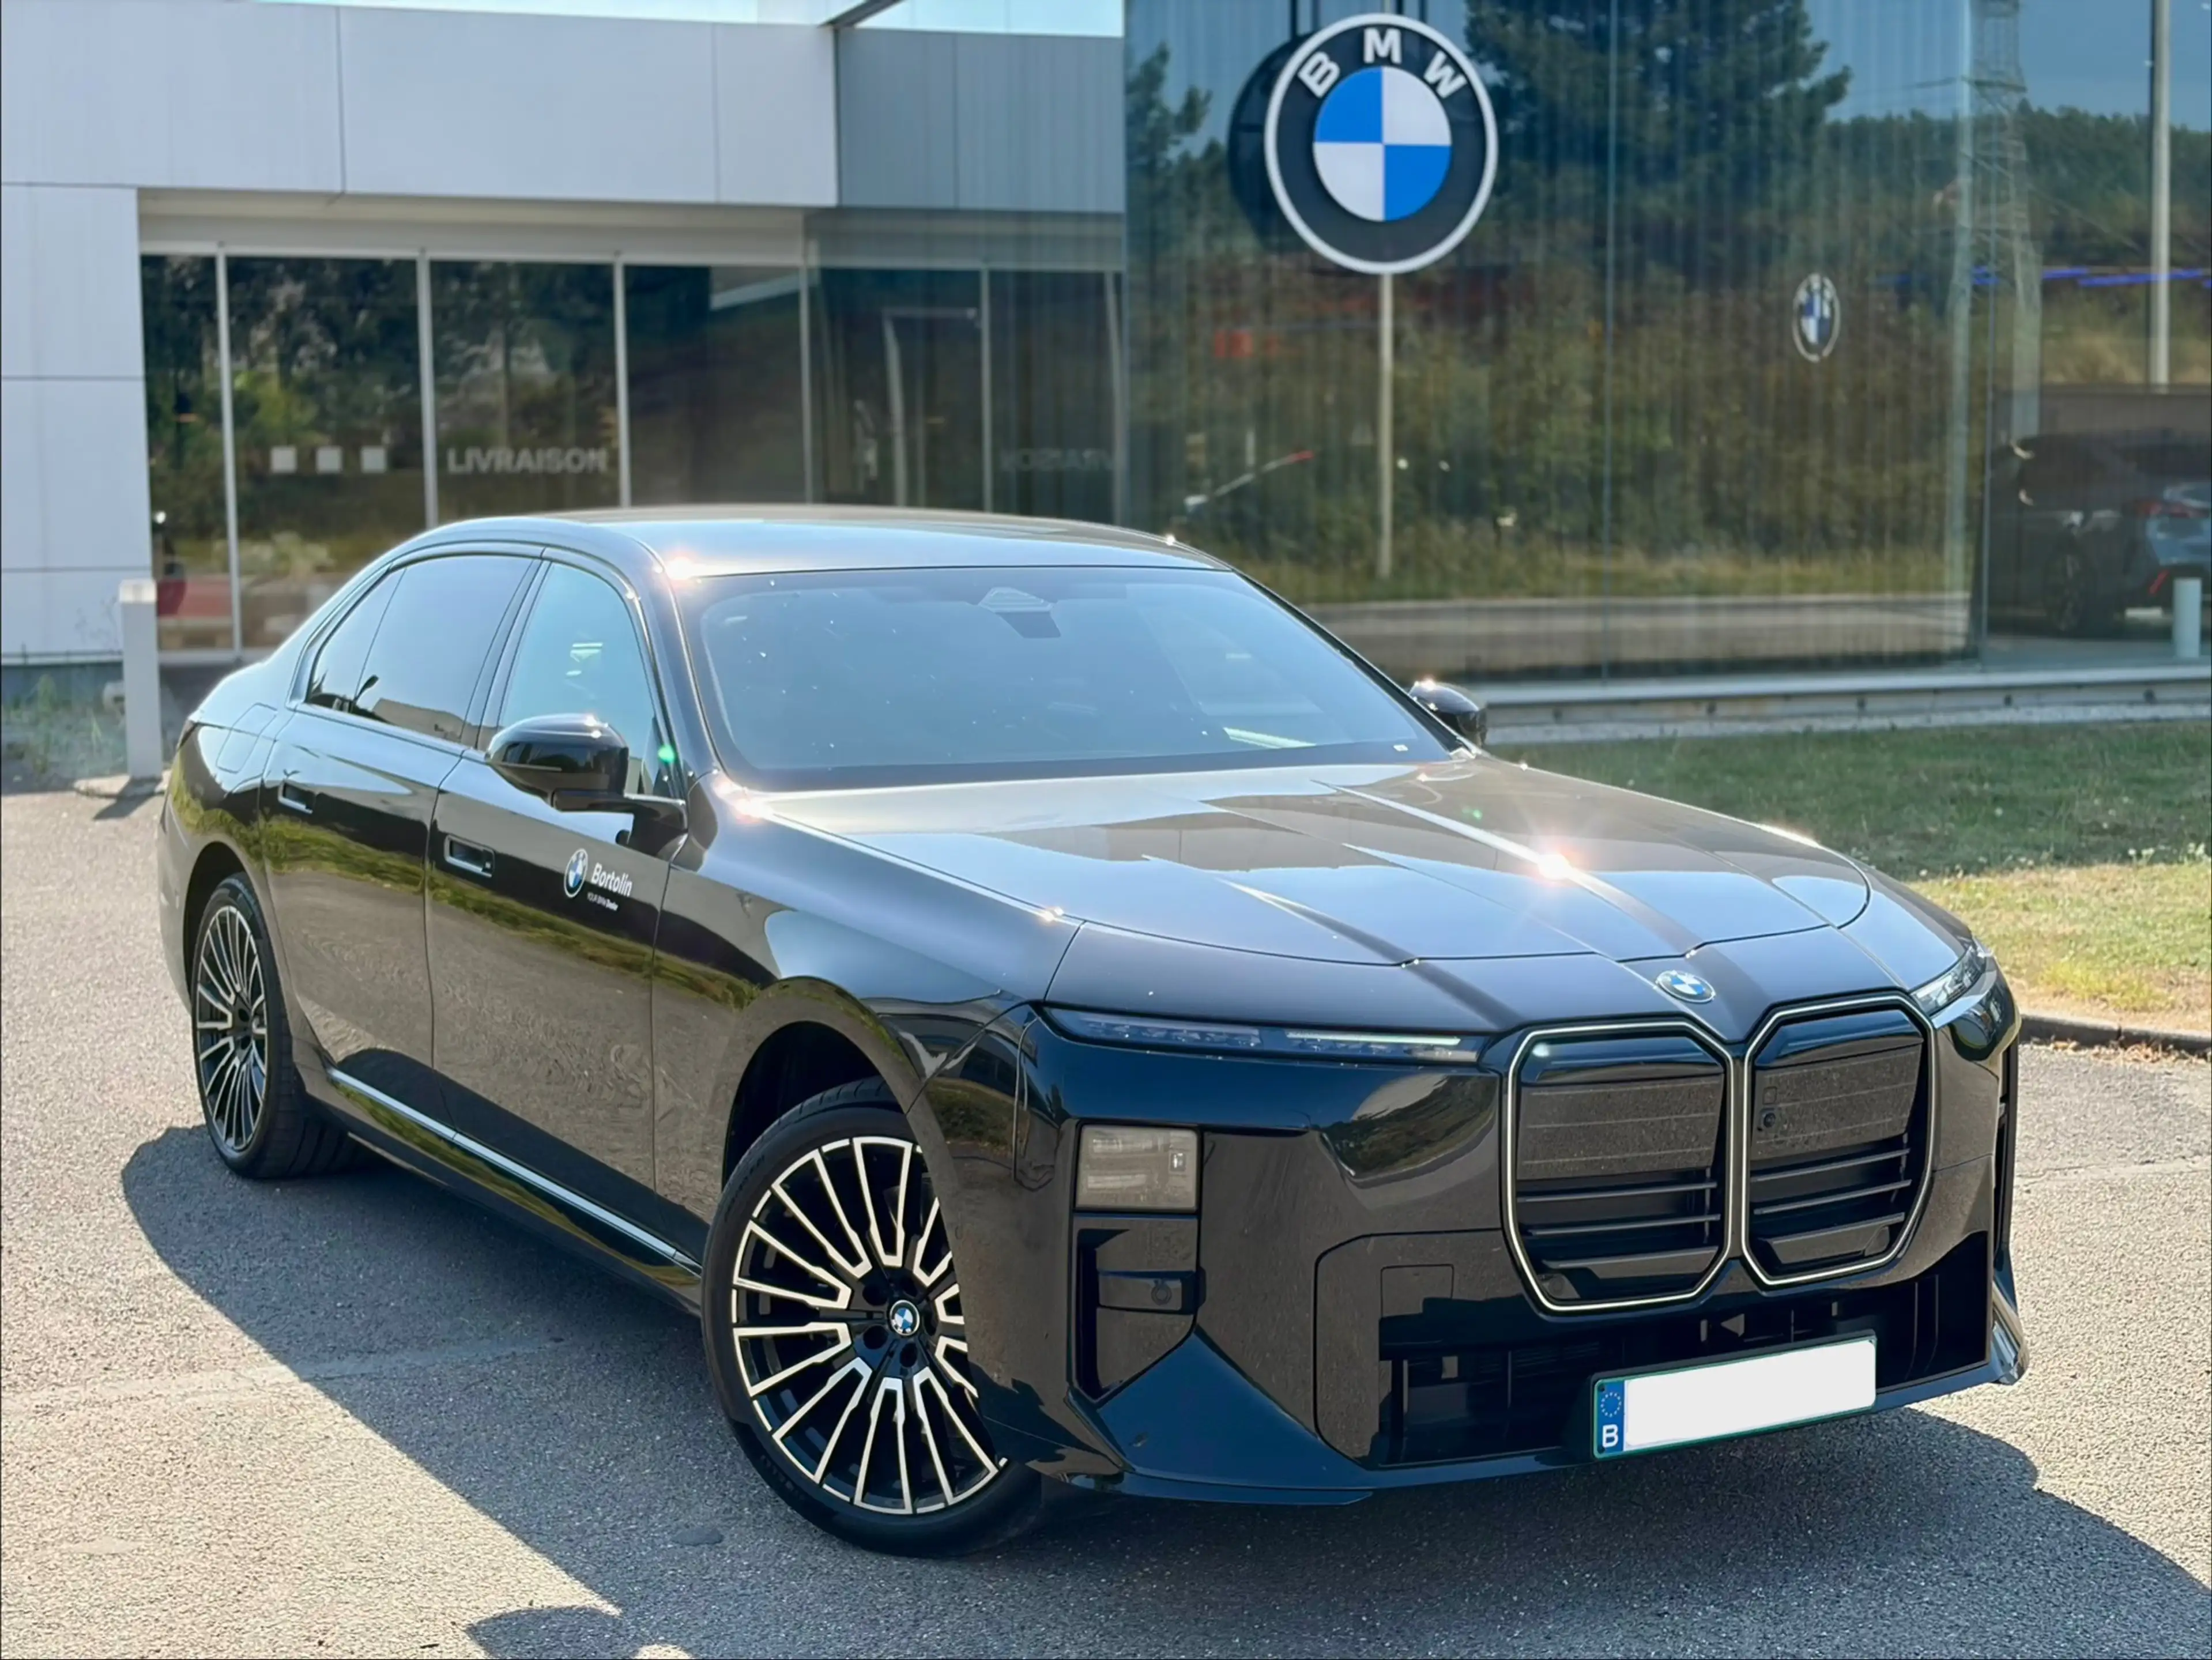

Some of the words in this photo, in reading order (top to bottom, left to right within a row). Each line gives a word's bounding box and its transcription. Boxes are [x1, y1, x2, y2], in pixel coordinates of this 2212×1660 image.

[1297, 28, 1467, 99] BMW
[446, 447, 608, 474] LIVRAISON
[590, 862, 634, 897] Bortolin
[1601, 1423, 1619, 1448] B
